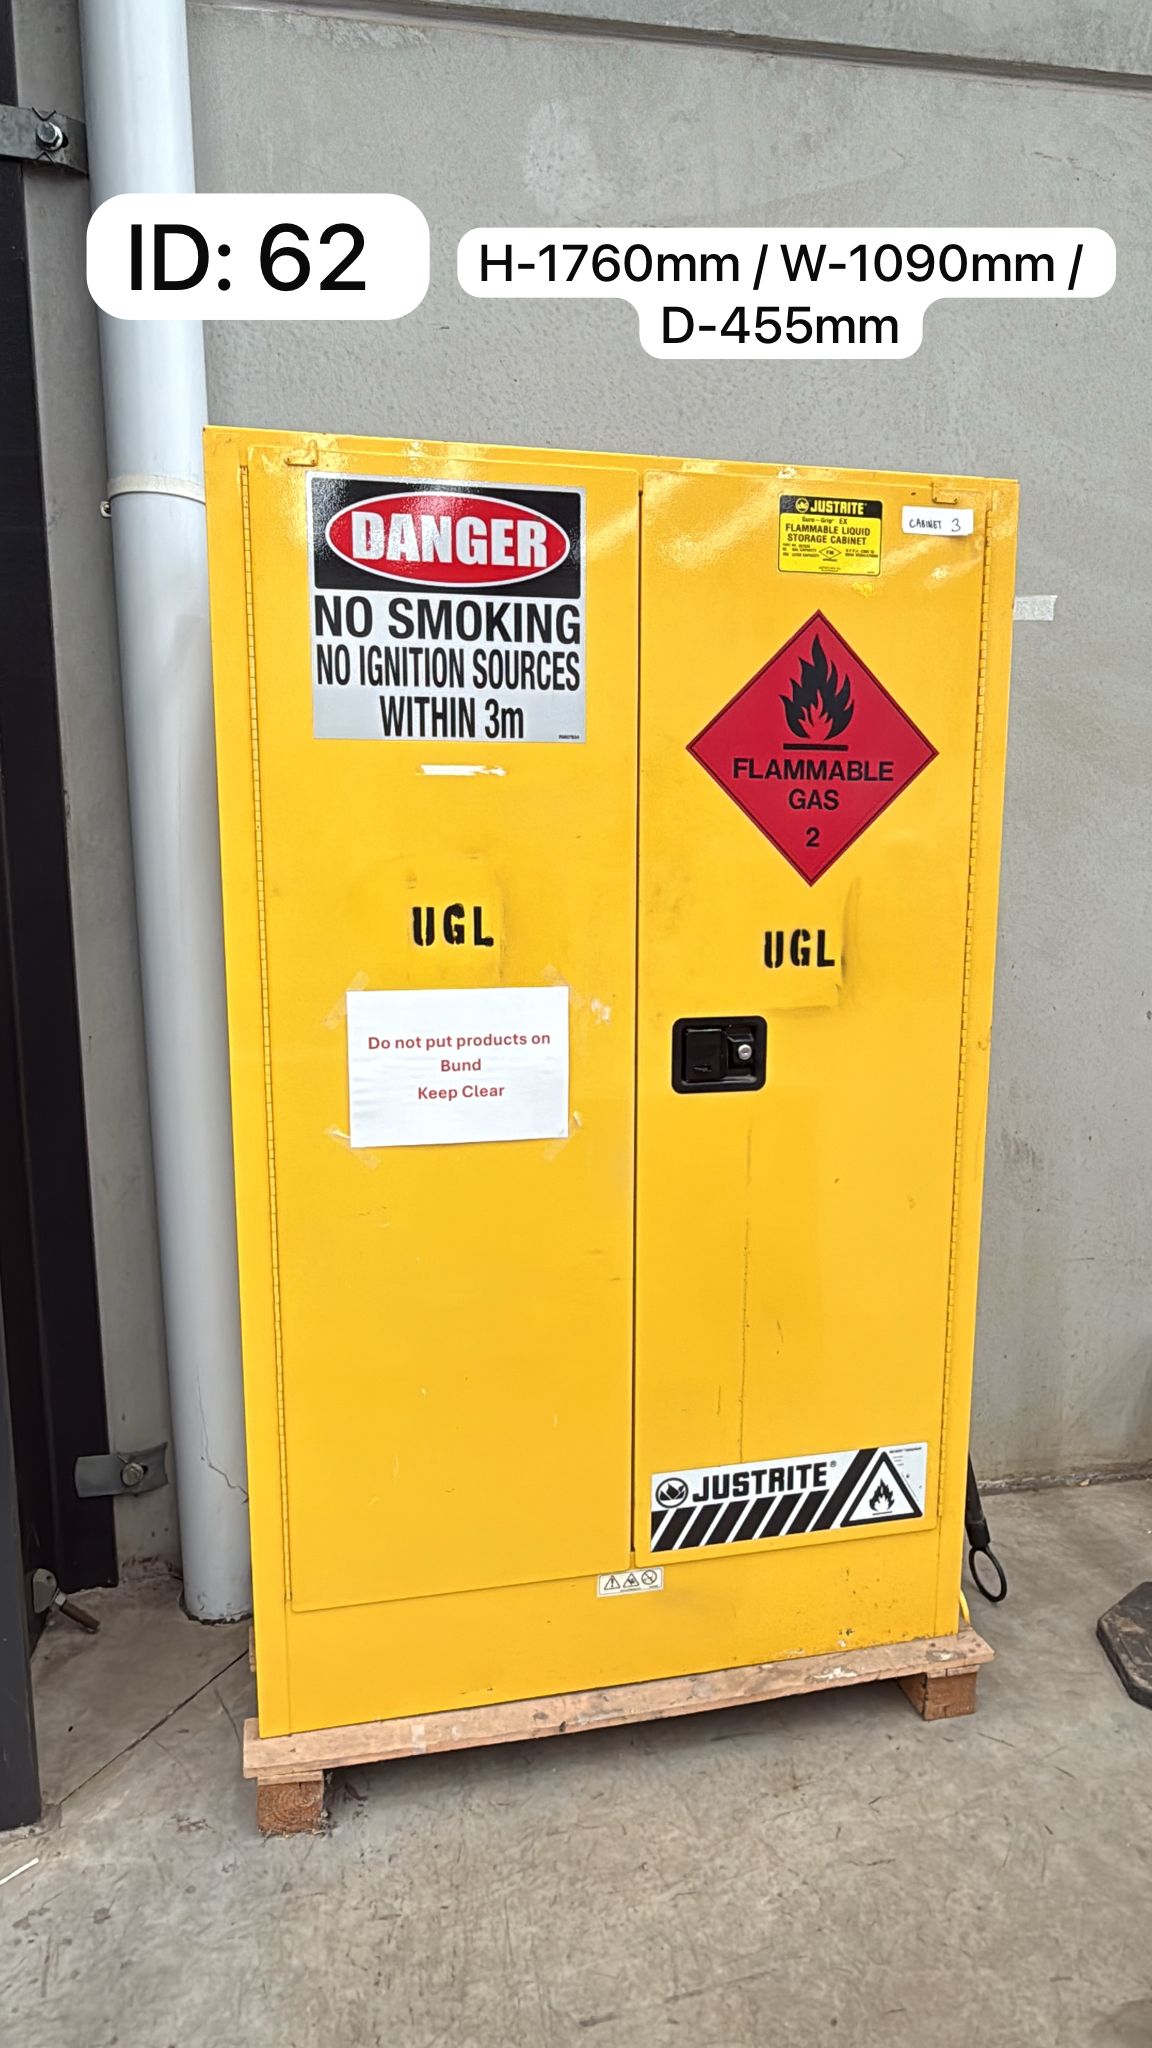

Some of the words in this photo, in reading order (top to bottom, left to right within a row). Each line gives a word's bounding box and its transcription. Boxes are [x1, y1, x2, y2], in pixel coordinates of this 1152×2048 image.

[785, 523, 839, 535] FLAMMABLE
[841, 526, 871, 537] LIQUID
[908, 518, 942, 530] CABINET
[951, 518, 962, 533] 3
[351, 511, 548, 567] DANGER
[787, 533, 828, 544] STORAGE
[830, 535, 867, 545] CABINET
[314, 594, 373, 638] NO
[388, 597, 581, 644] SMOKING
[317, 644, 351, 685] NO
[359, 645, 465, 688] IGNITION
[472, 648, 581, 691] SOURCES
[379, 695, 476, 738] WITHIN
[484, 698, 524, 739] 3m
[732, 758, 894, 782] FLAMMABLE
[788, 788, 840, 811] GAS
[805, 827, 820, 847] 2
[411, 902, 495, 947] UGL
[763, 928, 836, 969] UGL
[367, 1036, 391, 1050] Do
[395, 1036, 422, 1049] not
[425, 1036, 452, 1050] put
[456, 1034, 527, 1050] products
[531, 1034, 551, 1045] on
[440, 1058, 482, 1072] Bund
[418, 1086, 458, 1101] Keep
[462, 1085, 505, 1098] Clear
